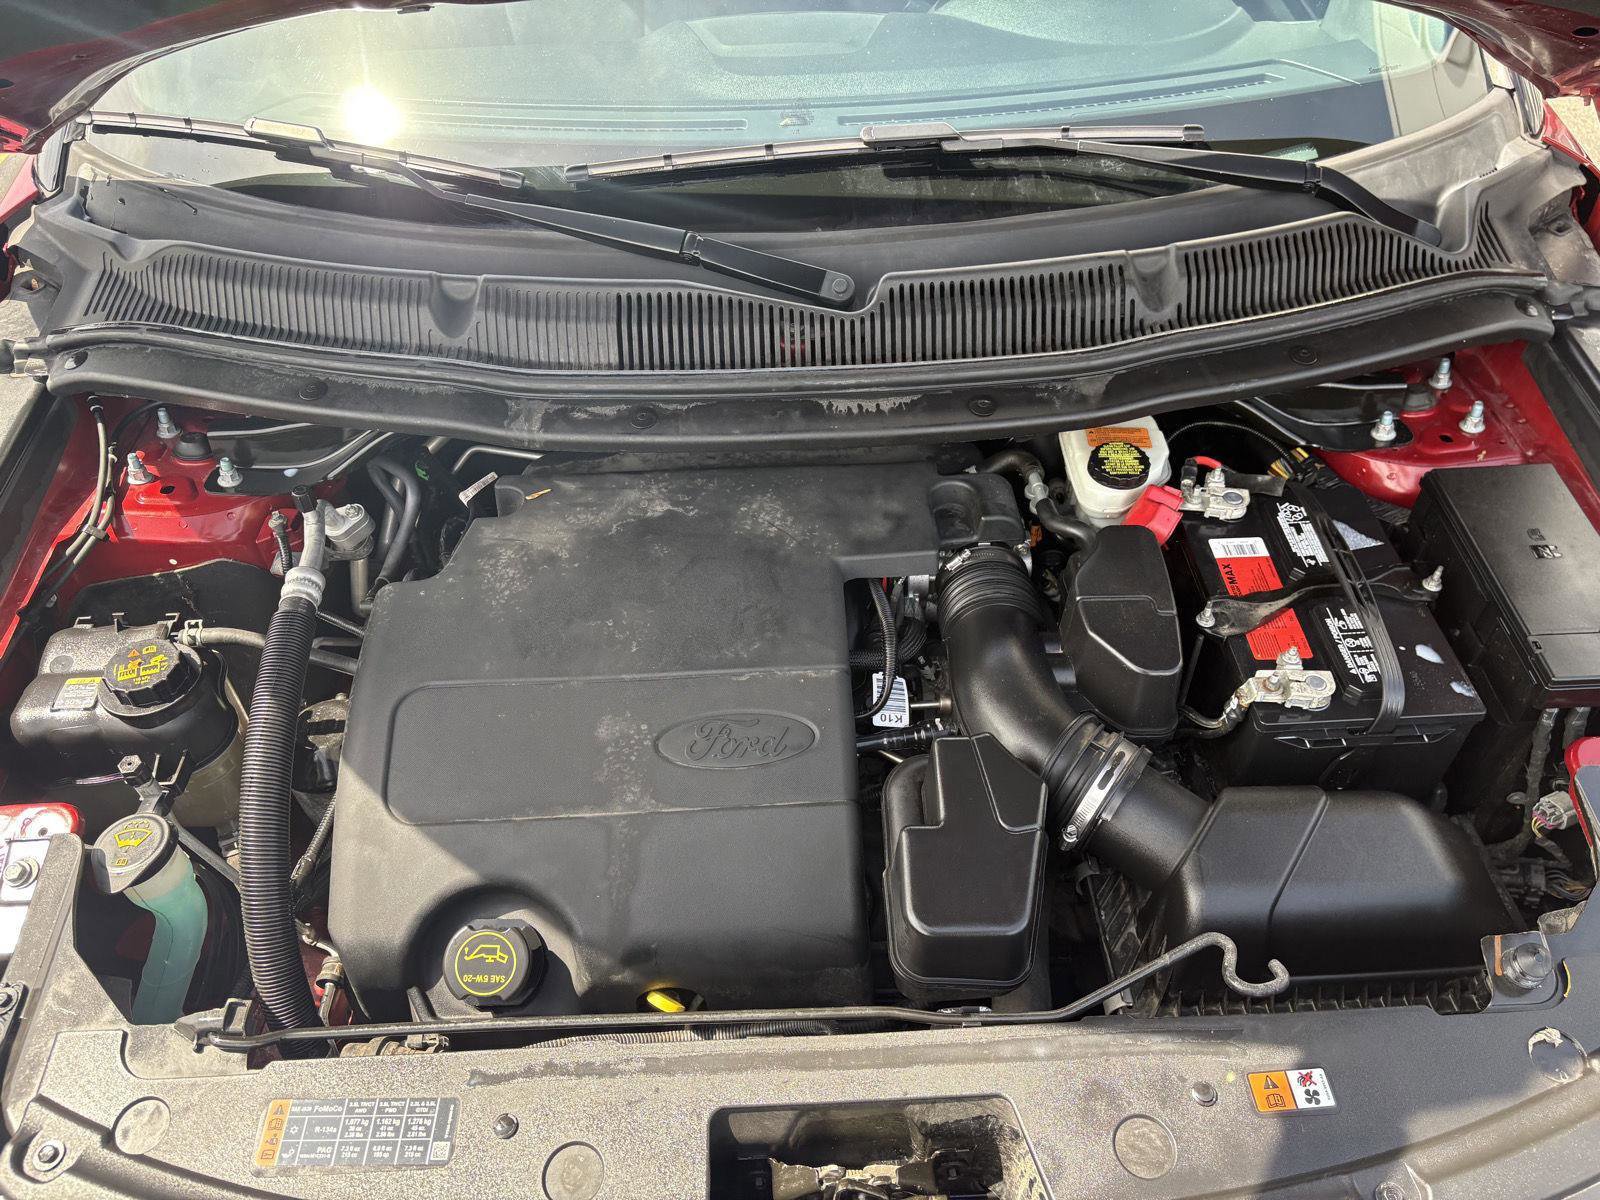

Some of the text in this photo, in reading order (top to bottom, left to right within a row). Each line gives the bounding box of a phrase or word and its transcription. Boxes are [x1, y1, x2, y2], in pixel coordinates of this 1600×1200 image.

[1222, 563, 1238, 586] MAX
[1338, 644, 1354, 669] DANGER
[880, 713, 903, 724] K10
[684, 718, 790, 762] Ford
[463, 974, 506, 983] SAE 5W-20
[313, 1105, 343, 1113] FoMoCo
[423, 1118, 432, 1126] kg
